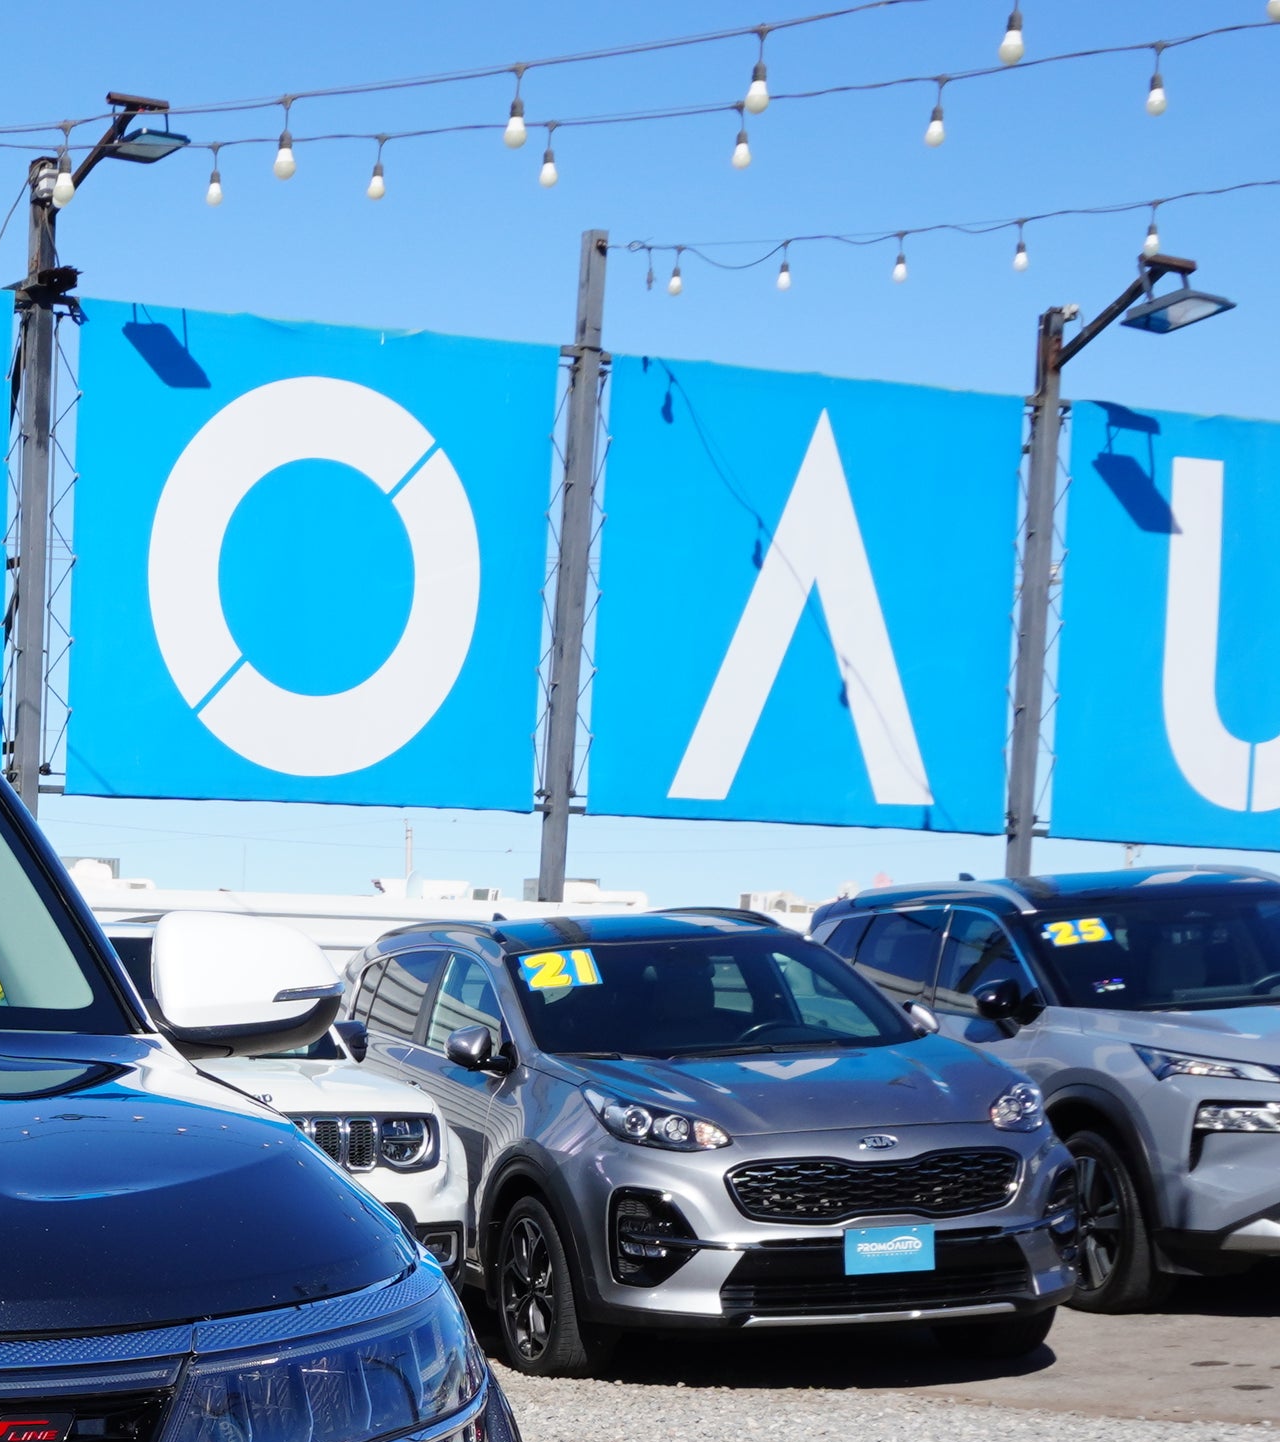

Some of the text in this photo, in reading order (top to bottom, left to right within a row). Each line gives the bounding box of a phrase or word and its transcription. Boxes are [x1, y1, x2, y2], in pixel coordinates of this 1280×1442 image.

[1048, 918, 1106, 946] 25
[524, 950, 599, 989] 21
[862, 1136, 894, 1148] KIA
[857, 1239, 922, 1252] PROMOAUTO
[7, 1430, 59, 1442] LINE
